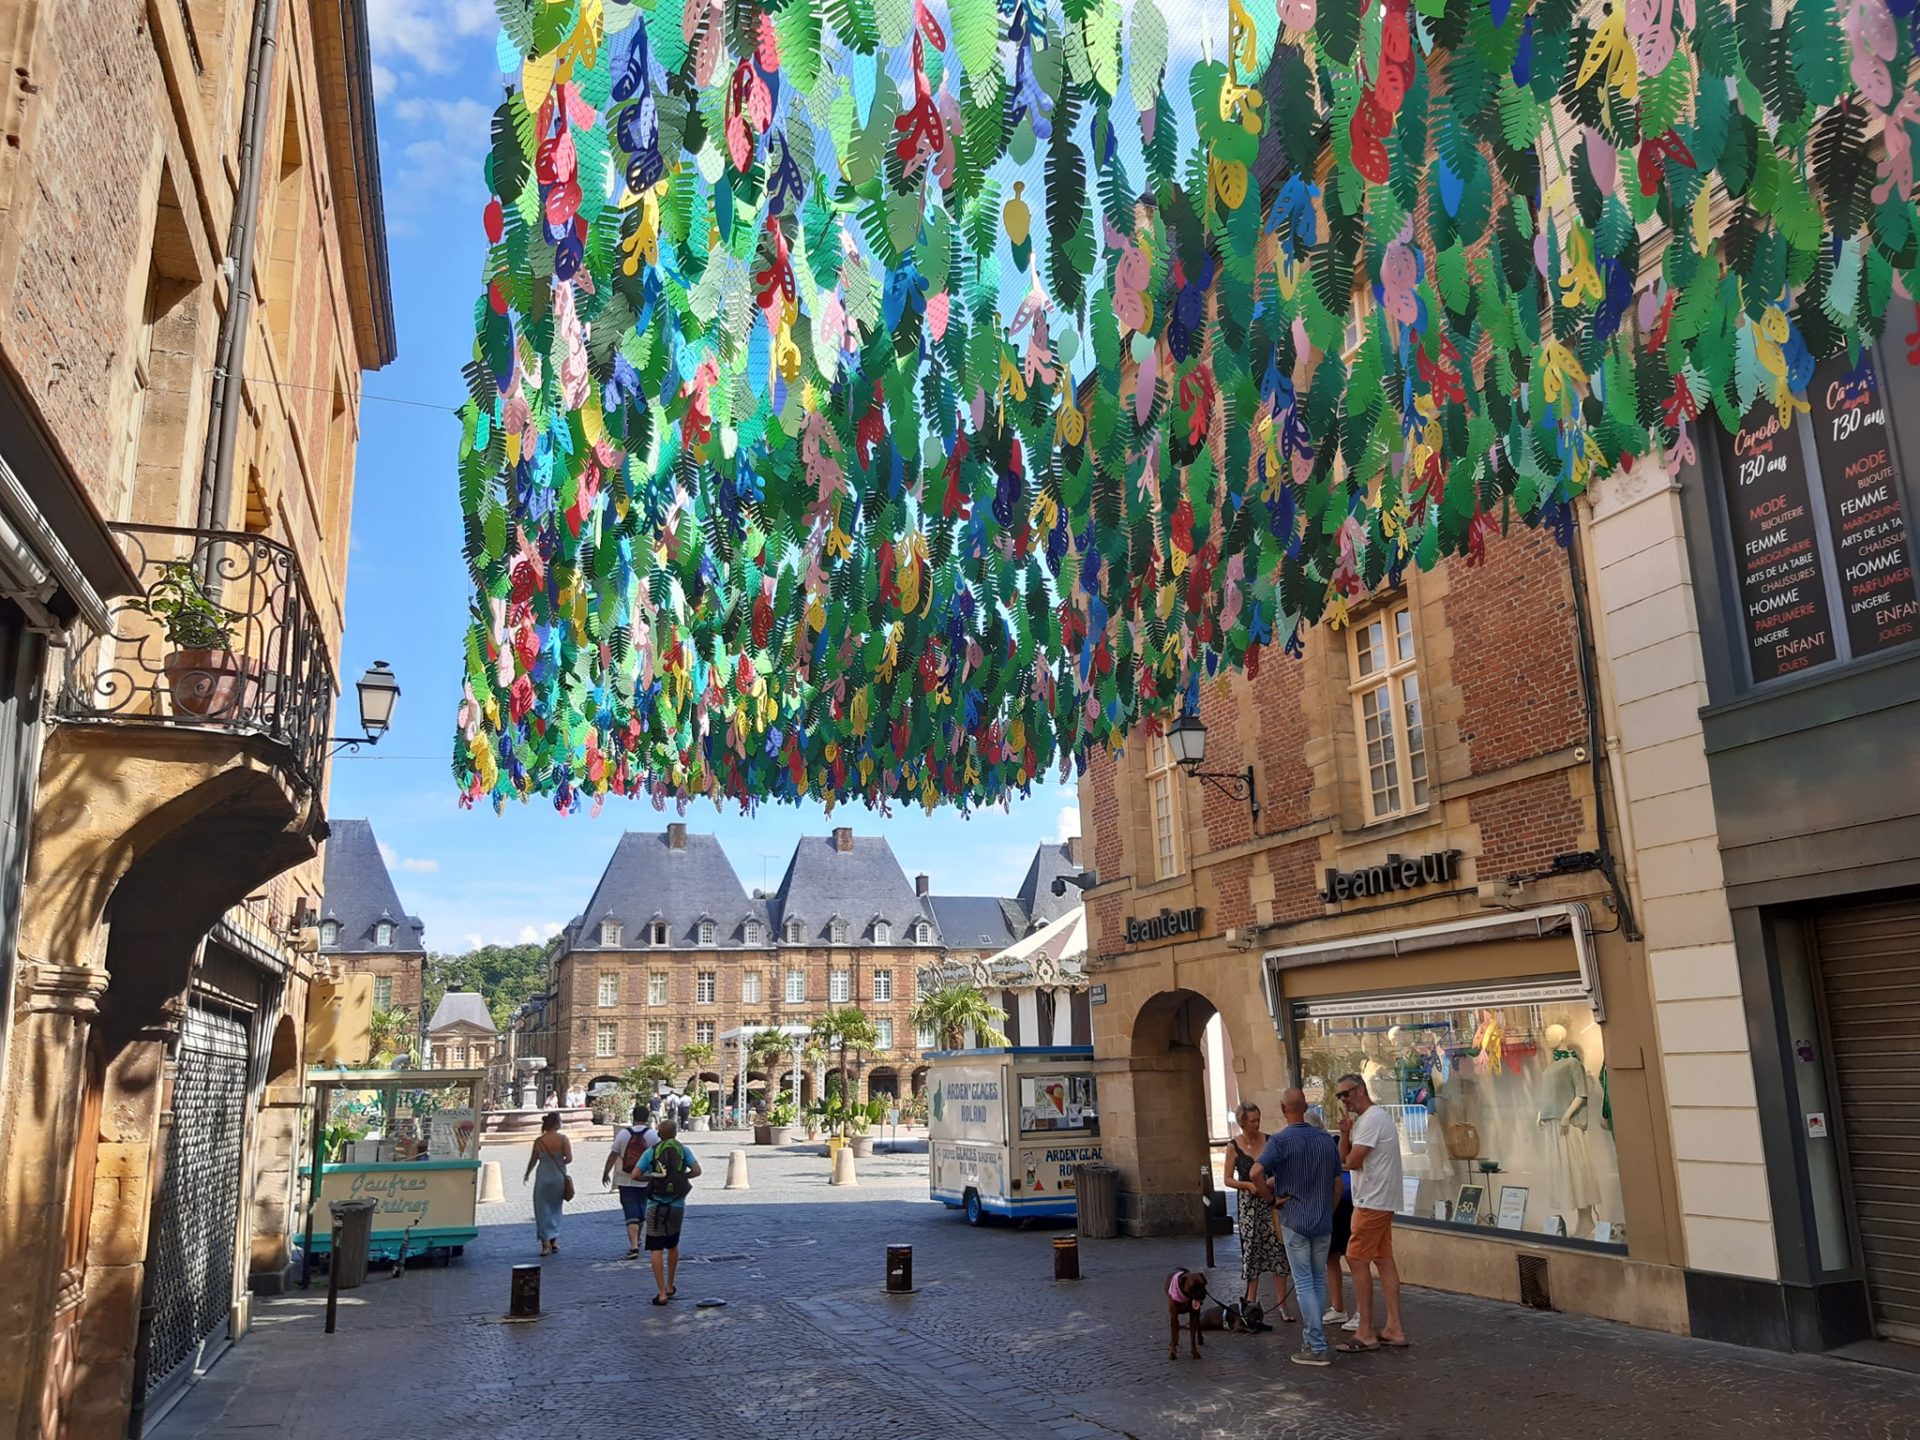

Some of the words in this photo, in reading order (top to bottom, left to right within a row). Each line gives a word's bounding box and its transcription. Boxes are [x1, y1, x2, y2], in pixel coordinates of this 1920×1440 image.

[1831, 407, 1861, 442] 130
[1863, 408, 1886, 427] ans
[1738, 455, 1765, 486] 130
[1767, 454, 1788, 472] ans
[1845, 449, 1888, 479] MODE
[1749, 494, 1788, 520] MODE
[1840, 485, 1889, 517] FEMME
[1760, 505, 1805, 530] BIJOUTERIE
[1745, 528, 1789, 556] FEMME
[1841, 533, 1863, 549] ARTS
[1863, 527, 1877, 540] DE
[1877, 522, 1890, 535] LA
[1745, 570, 1765, 586] ARTS
[1766, 566, 1777, 578] DE
[1778, 563, 1789, 573] LA
[1789, 552, 1814, 569] TABLE
[1747, 538, 1812, 571] MAROQUINERIE
[1845, 548, 1903, 581] HOMME
[1760, 567, 1816, 594] CHAUSSURES
[1749, 587, 1800, 617] HOMME
[1755, 601, 1816, 632] PARFUMERIE
[1850, 592, 1892, 614] LINGERIE
[1753, 627, 1791, 648] LINGERIE
[1775, 631, 1826, 659] ENFANT
[1878, 622, 1913, 642] JOUETS
[1777, 656, 1809, 673] JOUETS
[1319, 849, 1461, 903] Jeanteur
[1122, 907, 1204, 944] Jeanteur
[961, 1104, 987, 1123] ROLAND
